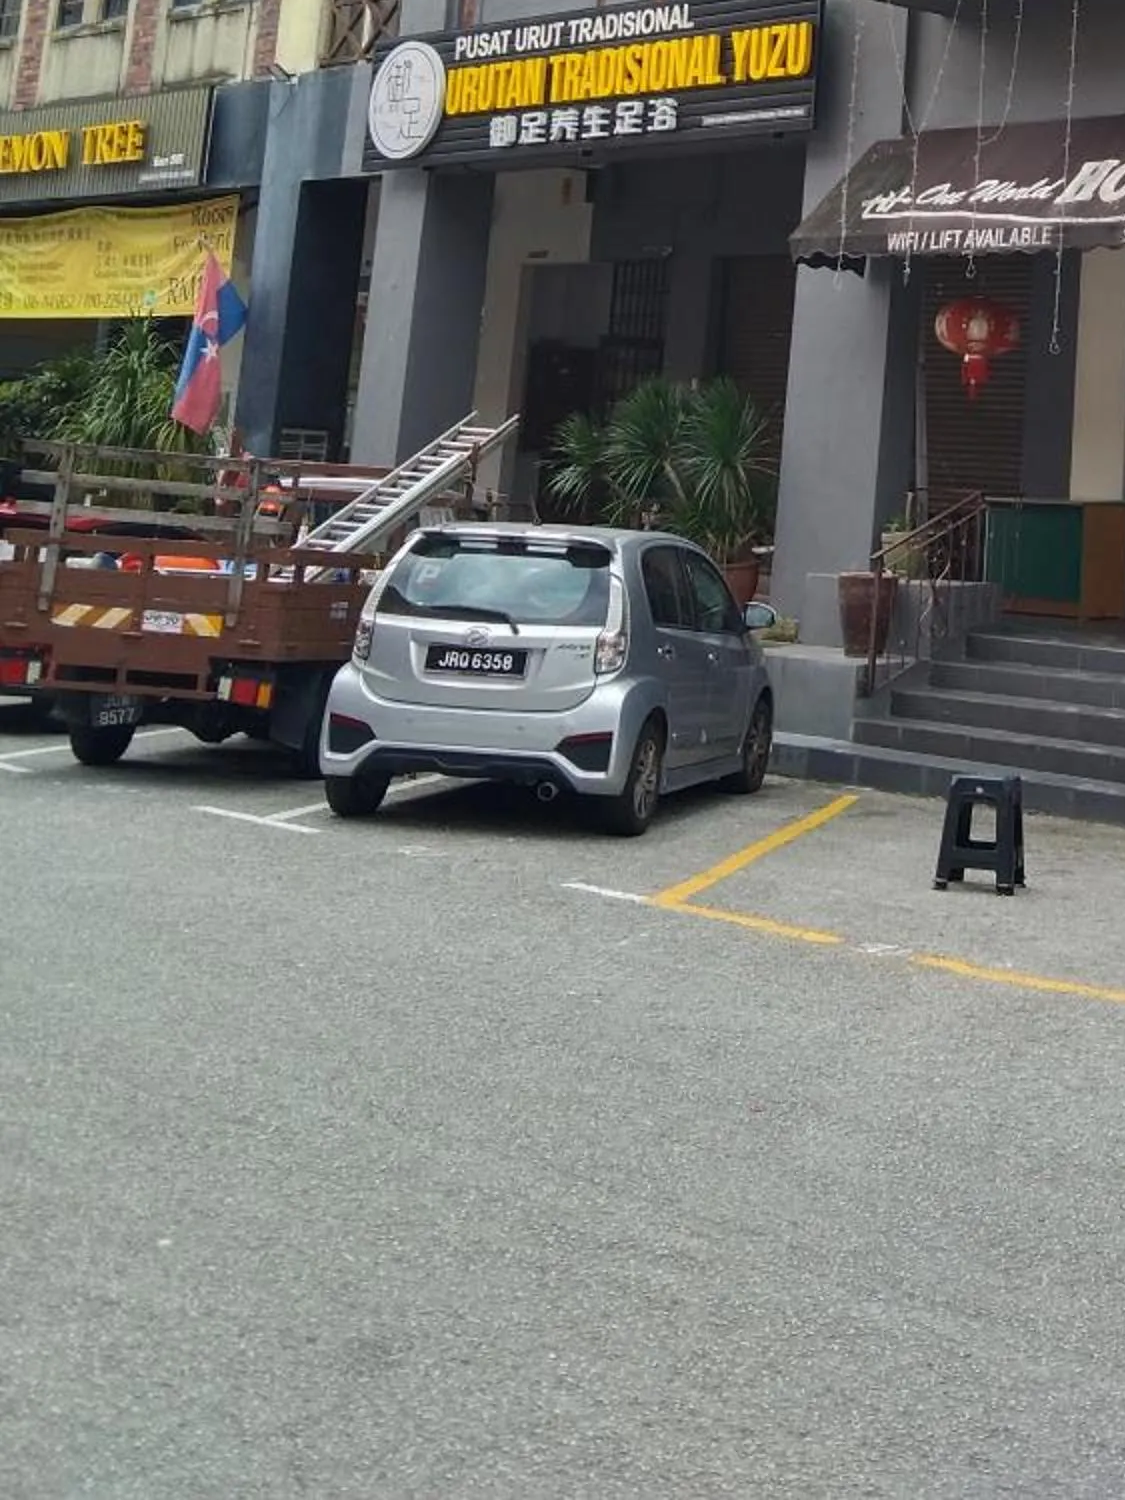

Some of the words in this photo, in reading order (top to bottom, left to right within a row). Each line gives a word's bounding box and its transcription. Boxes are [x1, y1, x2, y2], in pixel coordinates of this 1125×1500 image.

[455, 30, 513, 61] PUSAT
[515, 22, 566, 53] URUT
[567, 4, 695, 44] TRADISIONAL
[445, 56, 548, 117] URUTAN
[548, 34, 727, 104] TRADISIONAL
[732, 21, 814, 82] YUZU
[887, 231, 919, 252] WIFI
[930, 229, 962, 250] LIFT
[964, 225, 1052, 249] AVAILABLE
[471, 653, 513, 672] 6358
